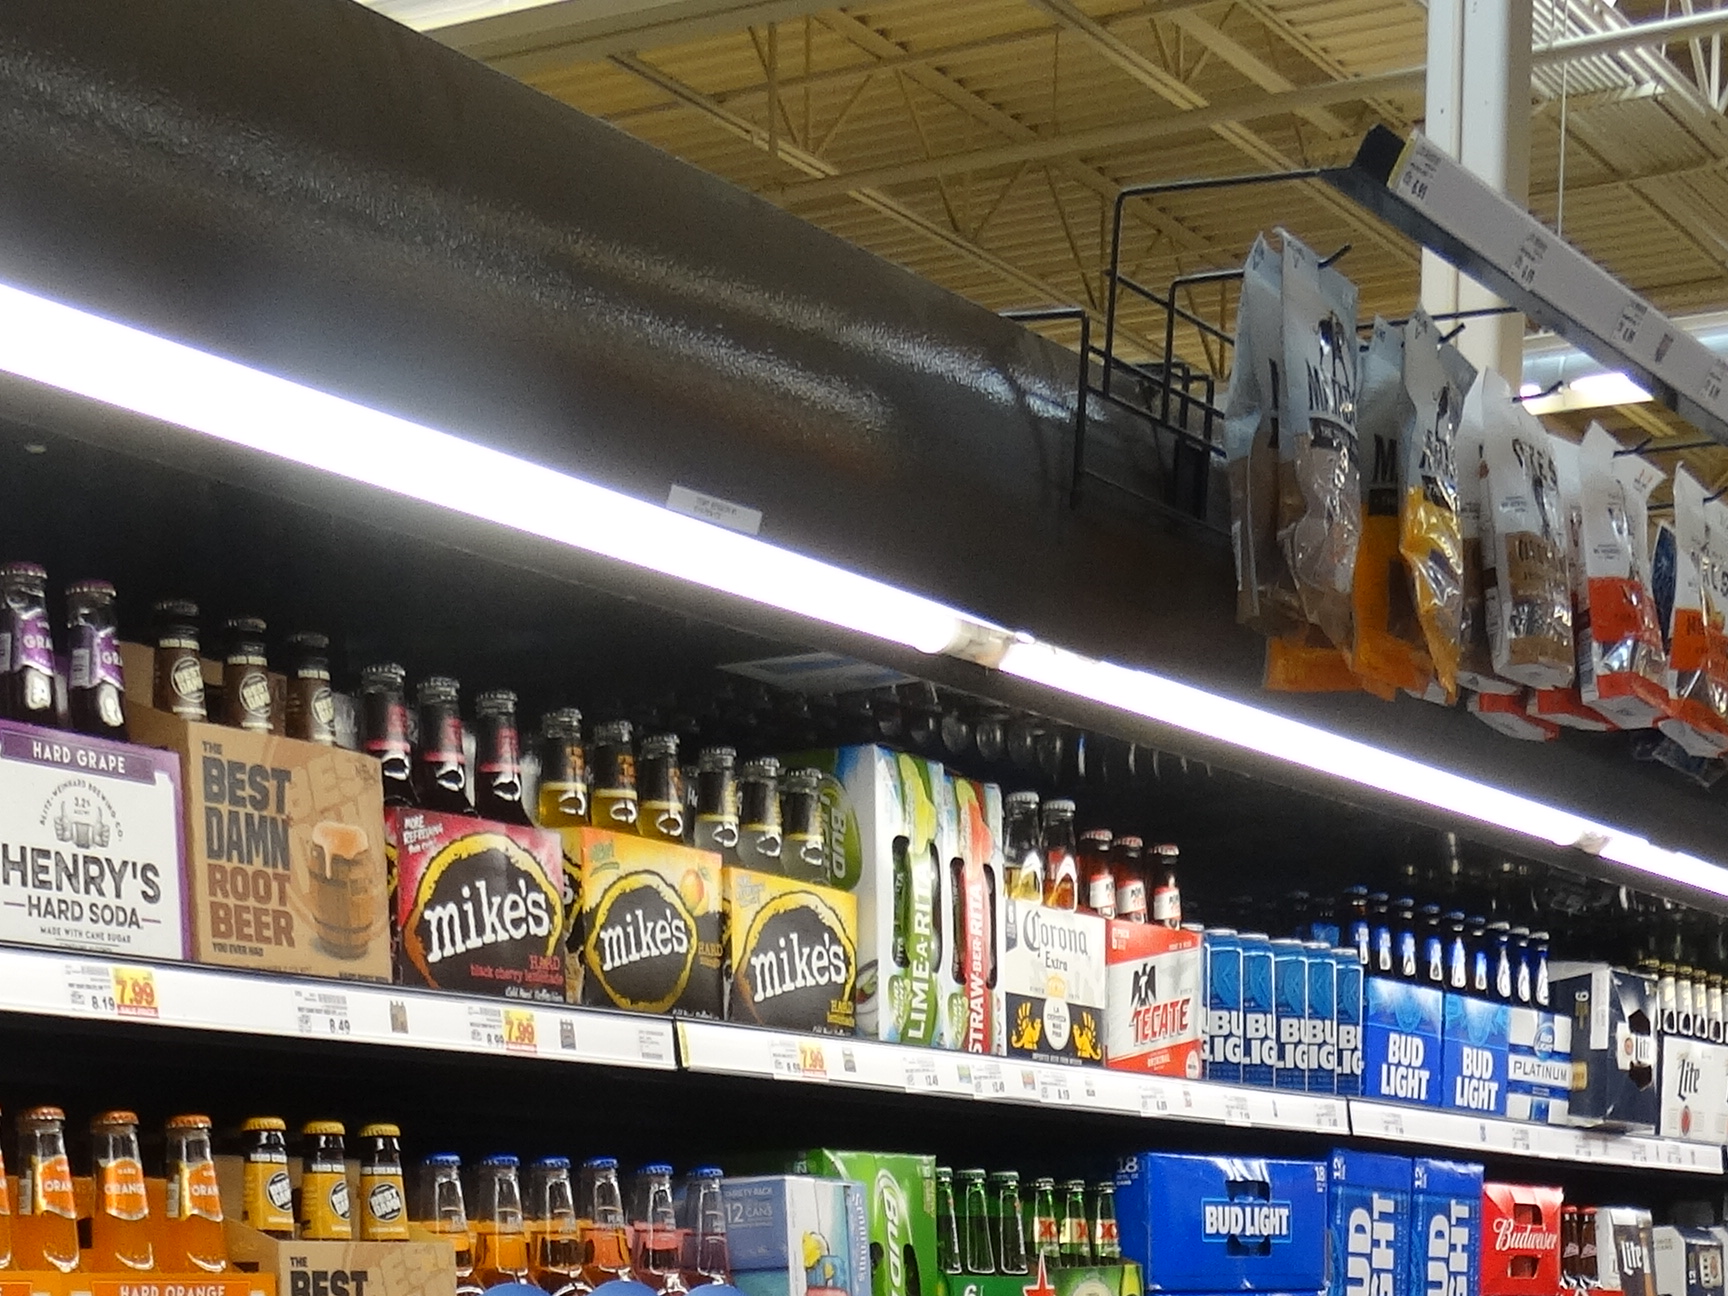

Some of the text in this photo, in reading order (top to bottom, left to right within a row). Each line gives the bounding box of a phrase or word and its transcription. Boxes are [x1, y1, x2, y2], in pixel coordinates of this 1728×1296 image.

[31, 741, 127, 773] HARD GRAPE
[202, 757, 293, 804] BEST
[205, 806, 292, 869] DAMN
[207, 864, 289, 905] ROOT
[209, 902, 296, 947] BEER
[423, 879, 551, 964] mike's
[1022, 911, 1089, 960] Corona
[749, 936, 847, 1004] mike's
[1044, 952, 1069, 972] Extra
[116, 981, 155, 1006] 7.99
[1130, 998, 1191, 1046] TECATE
[1387, 1034, 1426, 1068] BUD
[1512, 1061, 1568, 1082] PLATINUM
[1380, 1065, 1431, 1100] LIGHT
[1676, 1058, 1702, 1102] Lite
[1205, 1203, 1290, 1236] BUD LIGHT
[1492, 1218, 1559, 1252] Budweiser
